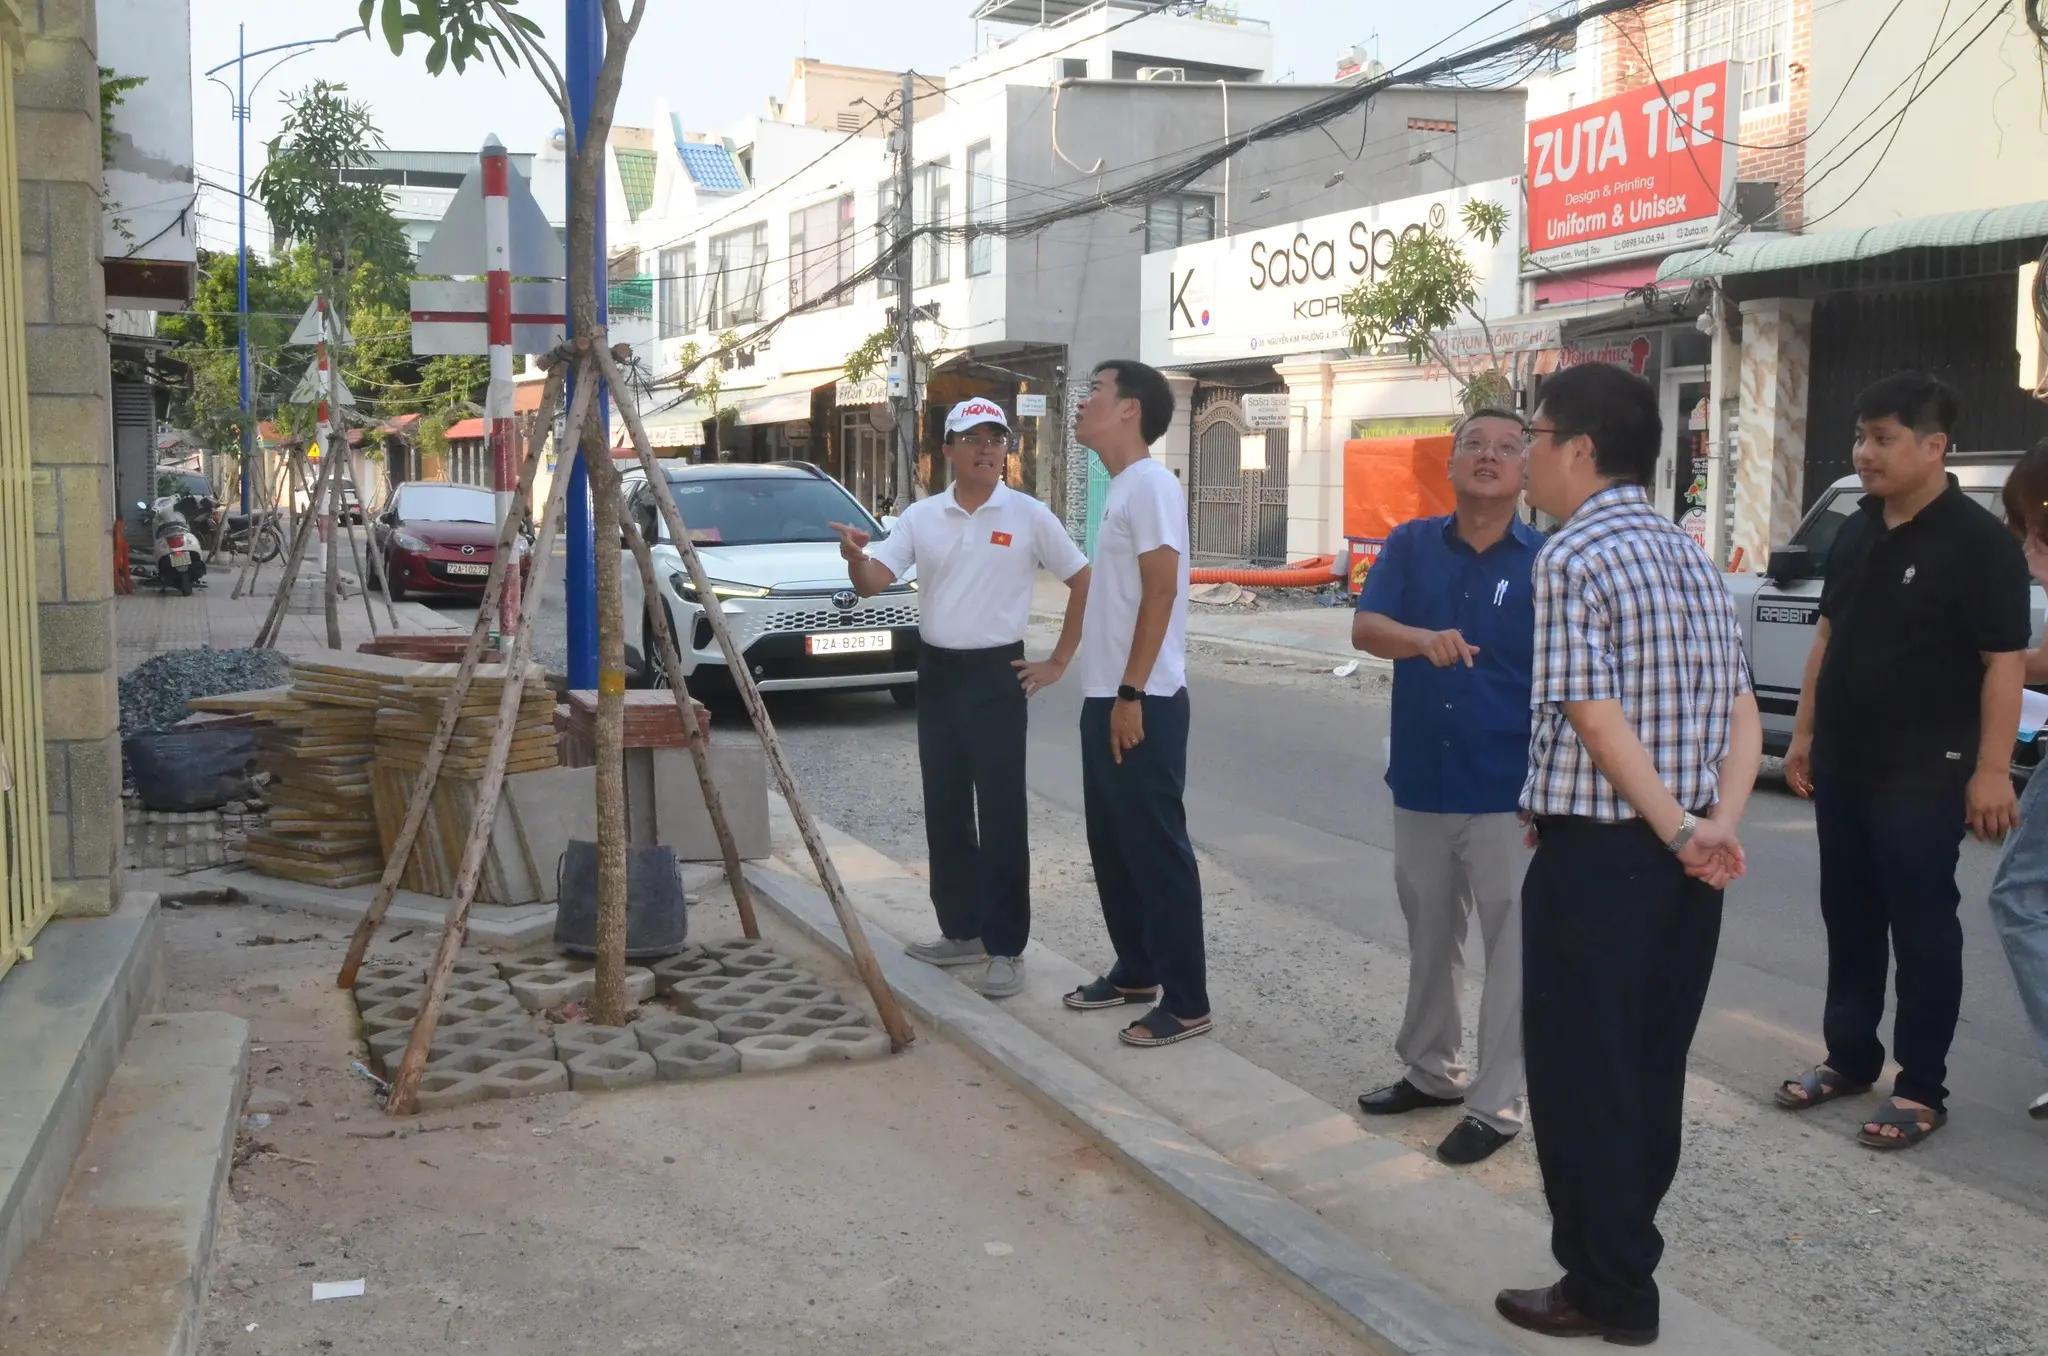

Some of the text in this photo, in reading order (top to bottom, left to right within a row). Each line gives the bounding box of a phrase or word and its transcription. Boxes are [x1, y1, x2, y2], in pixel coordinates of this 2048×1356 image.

[1533, 82, 1717, 189] ZUTA TEE
[1565, 176, 1655, 206] Design & Printing
[1547, 193, 1687, 240] Uniform & Unisex
[1250, 232, 1335, 291] SaSa
[1169, 268, 1195, 331] K
[1294, 296, 1353, 320] KORE
[1760, 607, 1812, 624] RABBIT
